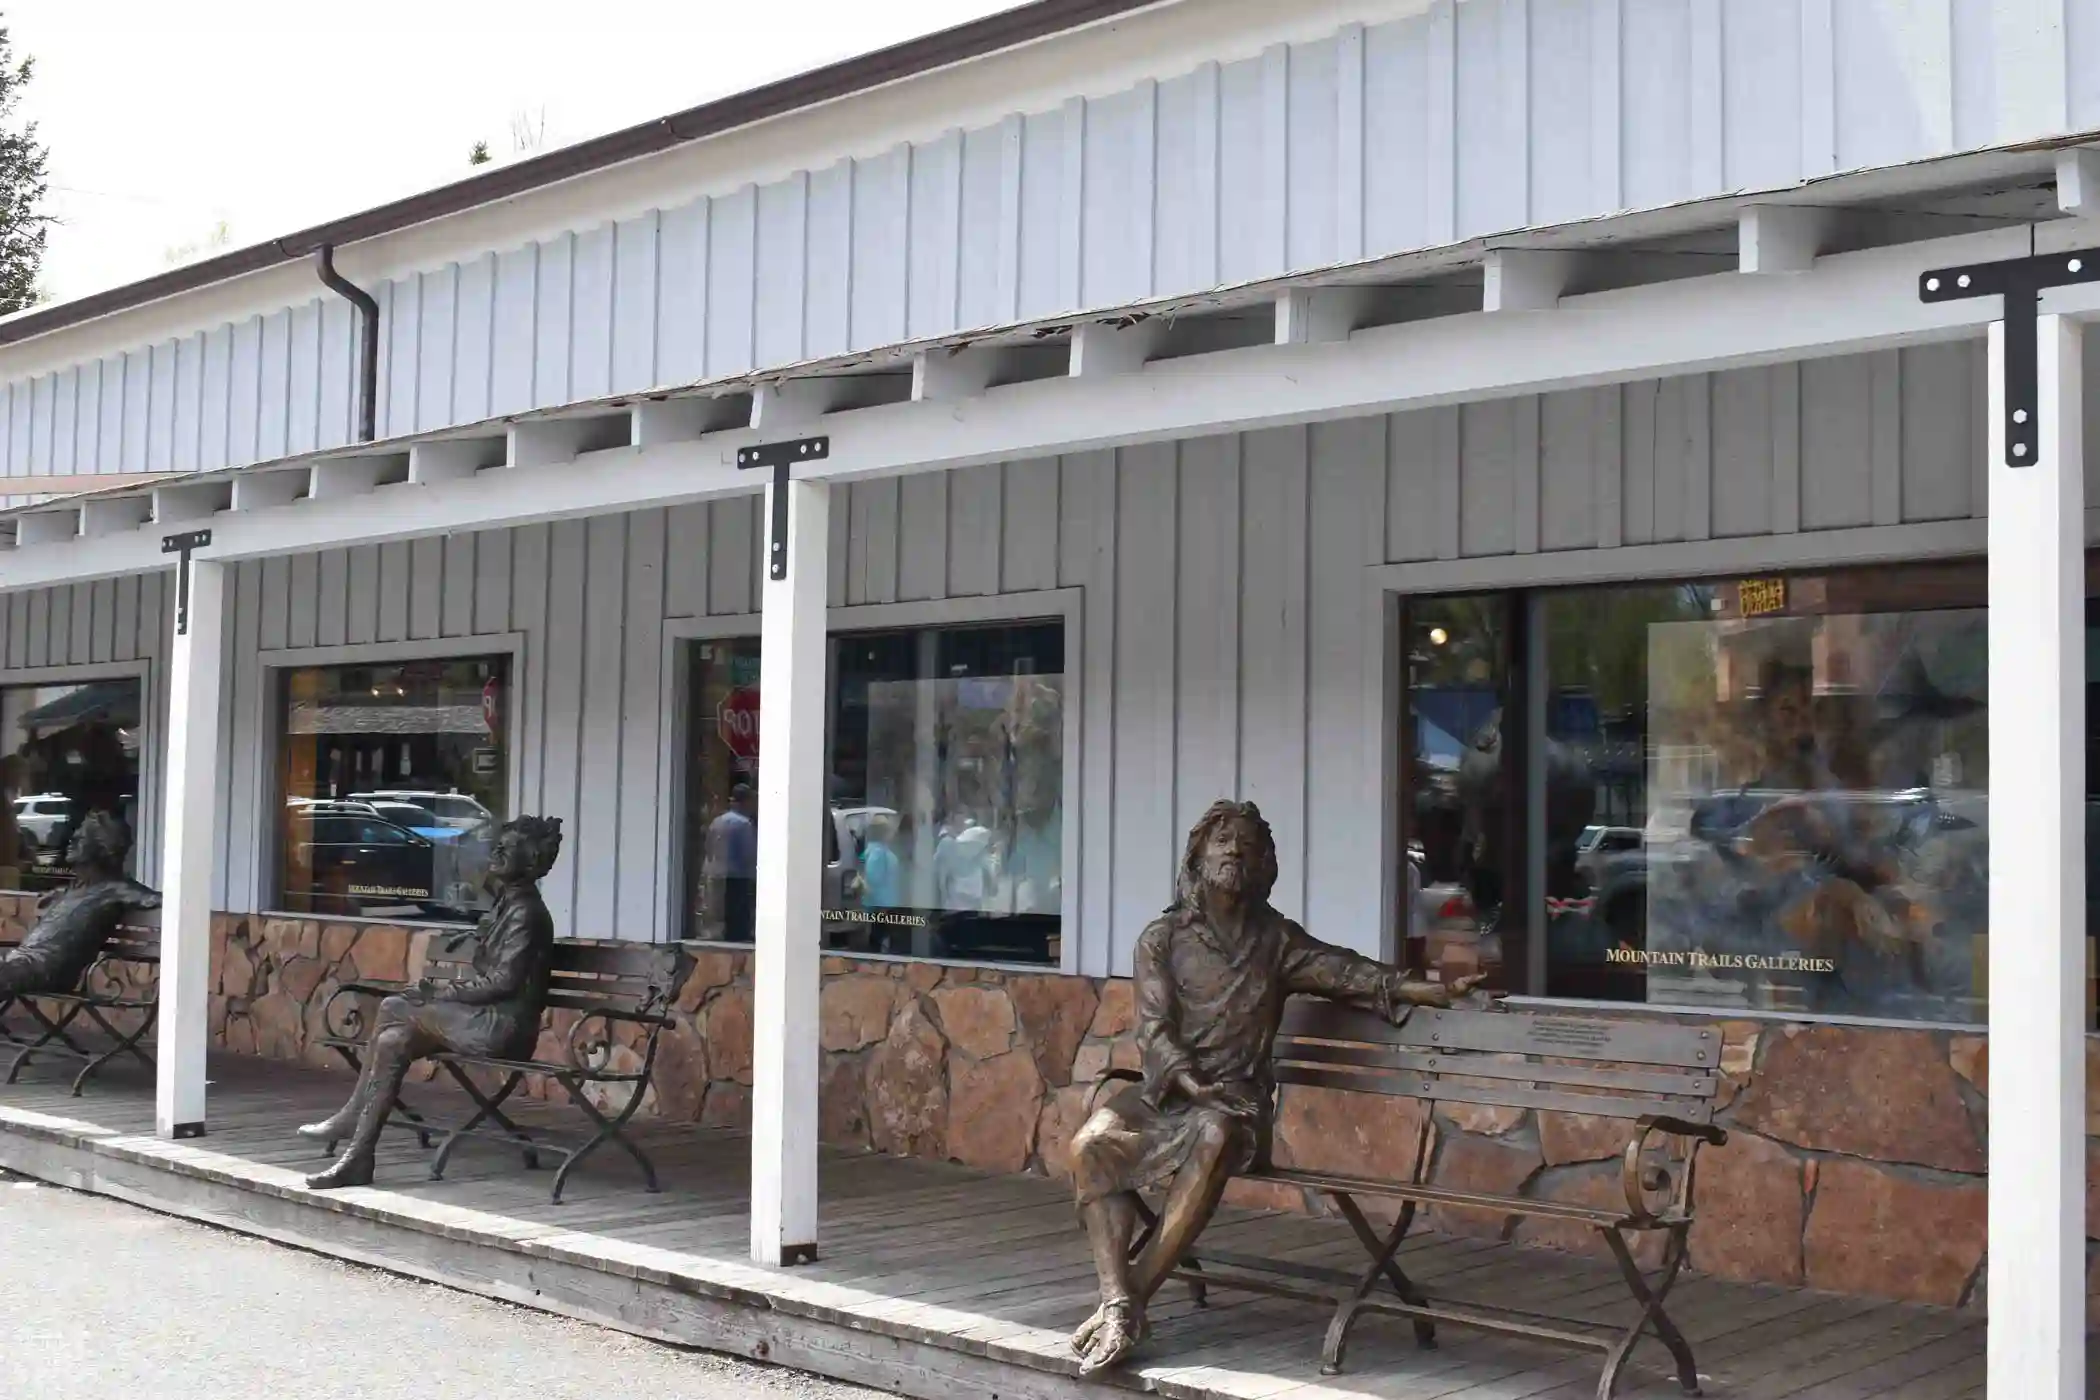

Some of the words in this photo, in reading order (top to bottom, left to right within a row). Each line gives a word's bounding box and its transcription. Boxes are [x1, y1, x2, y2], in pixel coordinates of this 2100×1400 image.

[820, 910, 845, 920] NTAIN
[845, 910, 876, 922] TRAILS
[877, 912, 926, 927] GALLERIES
[1605, 948, 1685, 965] MOUNTAIN
[1687, 952, 1743, 968] TRAILS
[1745, 954, 1834, 972] GALLERIES
